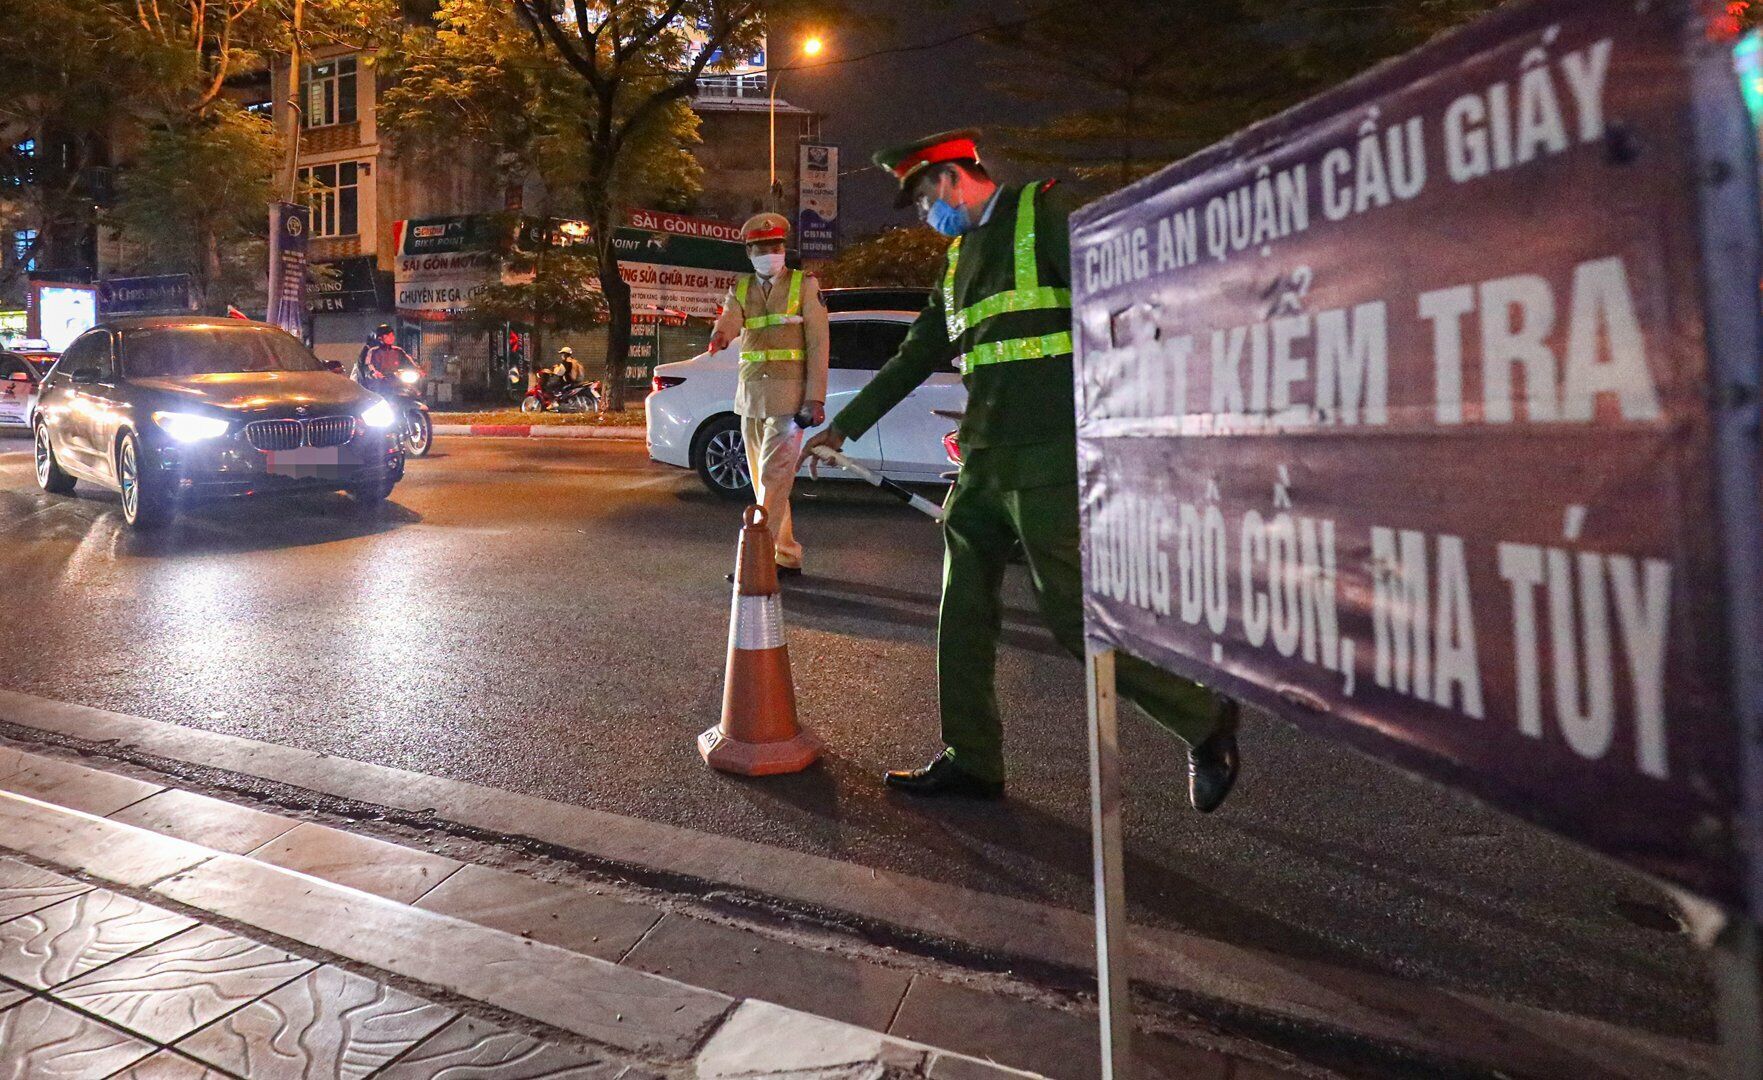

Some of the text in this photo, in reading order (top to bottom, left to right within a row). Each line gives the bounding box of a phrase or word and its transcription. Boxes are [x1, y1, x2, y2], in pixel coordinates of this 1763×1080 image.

[1157, 207, 1198, 272] AN
[1205, 163, 1309, 263] QUẬN
[1321, 105, 1428, 221] CẦU
[1444, 24, 1614, 184] GIẤY
[633, 211, 744, 240] SÀI GÒN MOTO
[399, 287, 434, 304] CHUYÊN
[436, 288, 447, 303] XE
[448, 287, 461, 302] GA
[639, 266, 657, 284] SỬA
[660, 269, 682, 287] CHỮA
[685, 273, 696, 287] XE
[698, 276, 709, 288] GA
[714, 277, 725, 289] XE
[1211, 265, 1388, 427] KIỂM
[1417, 256, 1662, 425] TRA
[1178, 479, 1228, 664] ĐỘ
[1241, 464, 1355, 695] CỒN,
[1371, 525, 1484, 721] MA
[1498, 504, 1674, 781] TÚY
